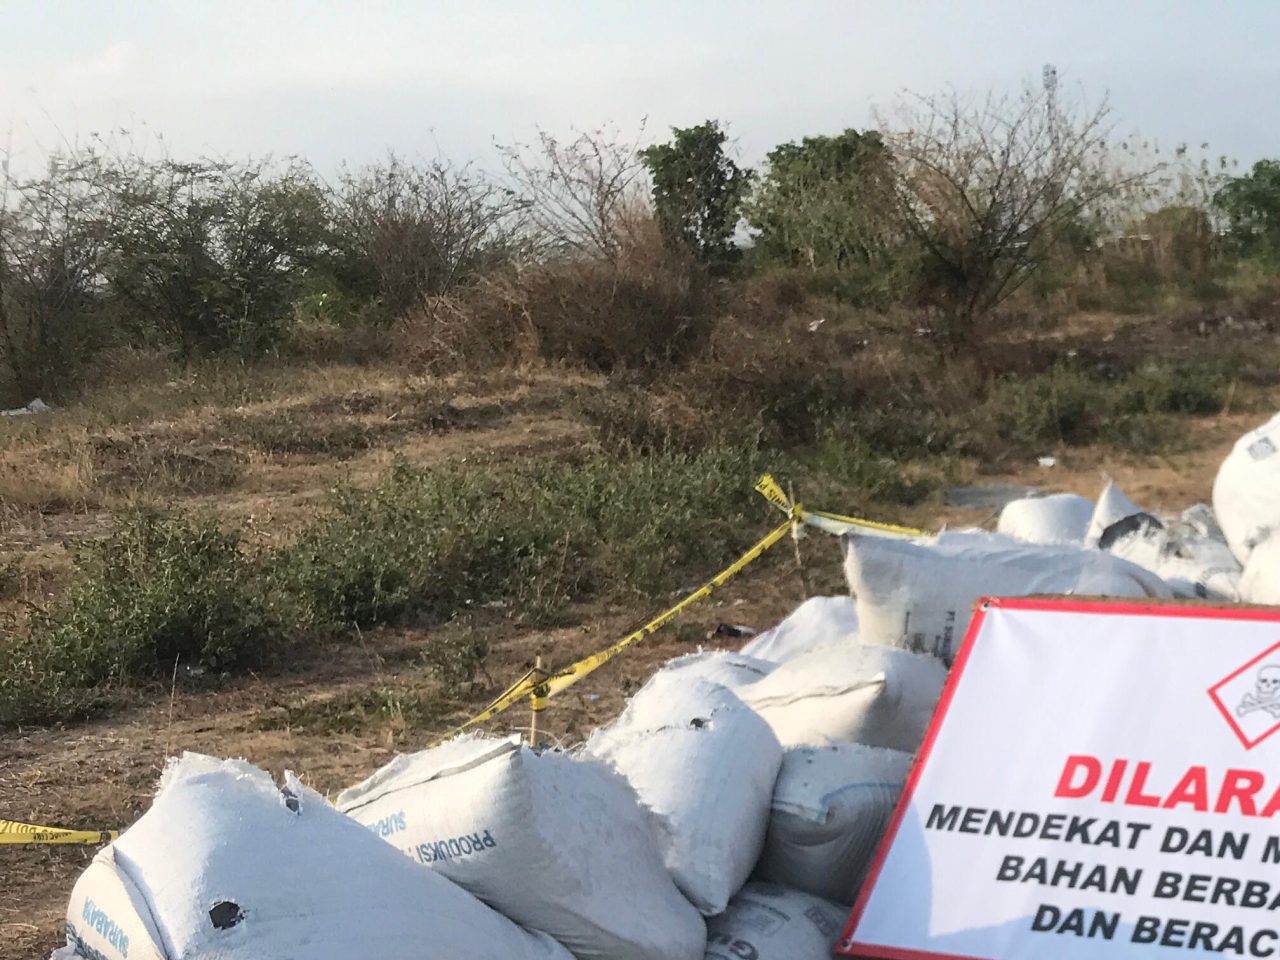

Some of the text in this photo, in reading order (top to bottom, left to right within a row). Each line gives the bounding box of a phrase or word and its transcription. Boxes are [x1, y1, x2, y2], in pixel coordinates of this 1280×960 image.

[926, 803, 1143, 850] MENDEKAT
[1160, 826, 1249, 861] DAN
[997, 855, 1142, 896] BAHAN
[1031, 904, 1120, 940] DAN
